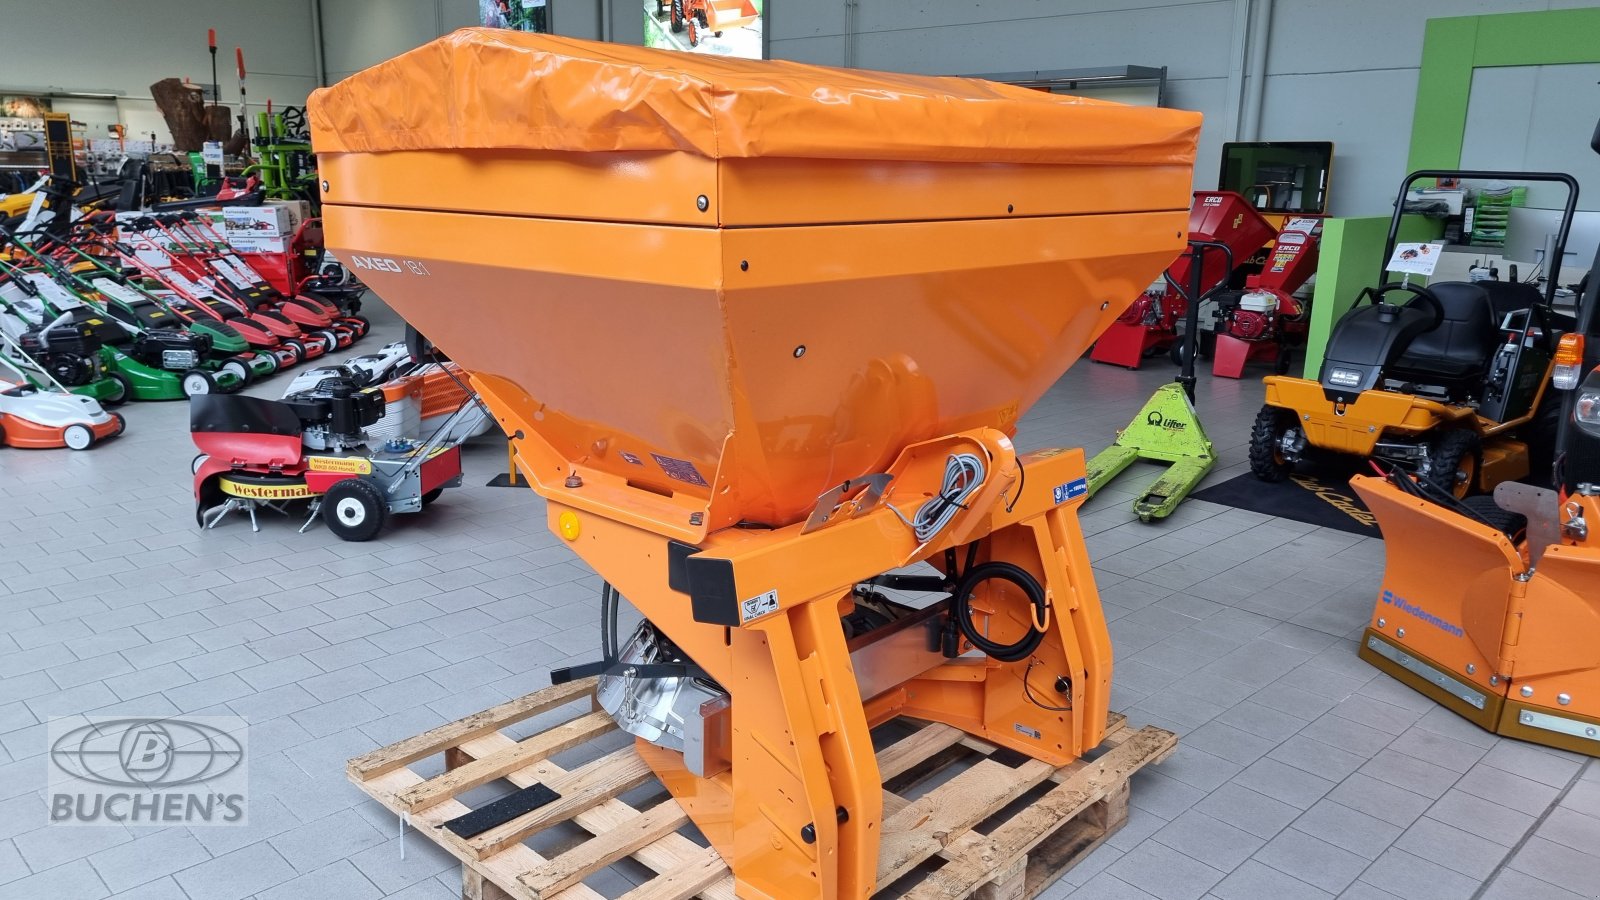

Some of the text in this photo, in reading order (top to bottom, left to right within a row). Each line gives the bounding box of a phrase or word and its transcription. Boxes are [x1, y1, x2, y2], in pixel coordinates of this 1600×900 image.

[351, 255, 431, 276] AXEO 18.1
[1330, 378, 1359, 386] MOTOR
[1163, 418, 1187, 428] Lifter
[313, 458, 355, 467] Westermann
[1394, 596, 1464, 638] Wiedenmann
